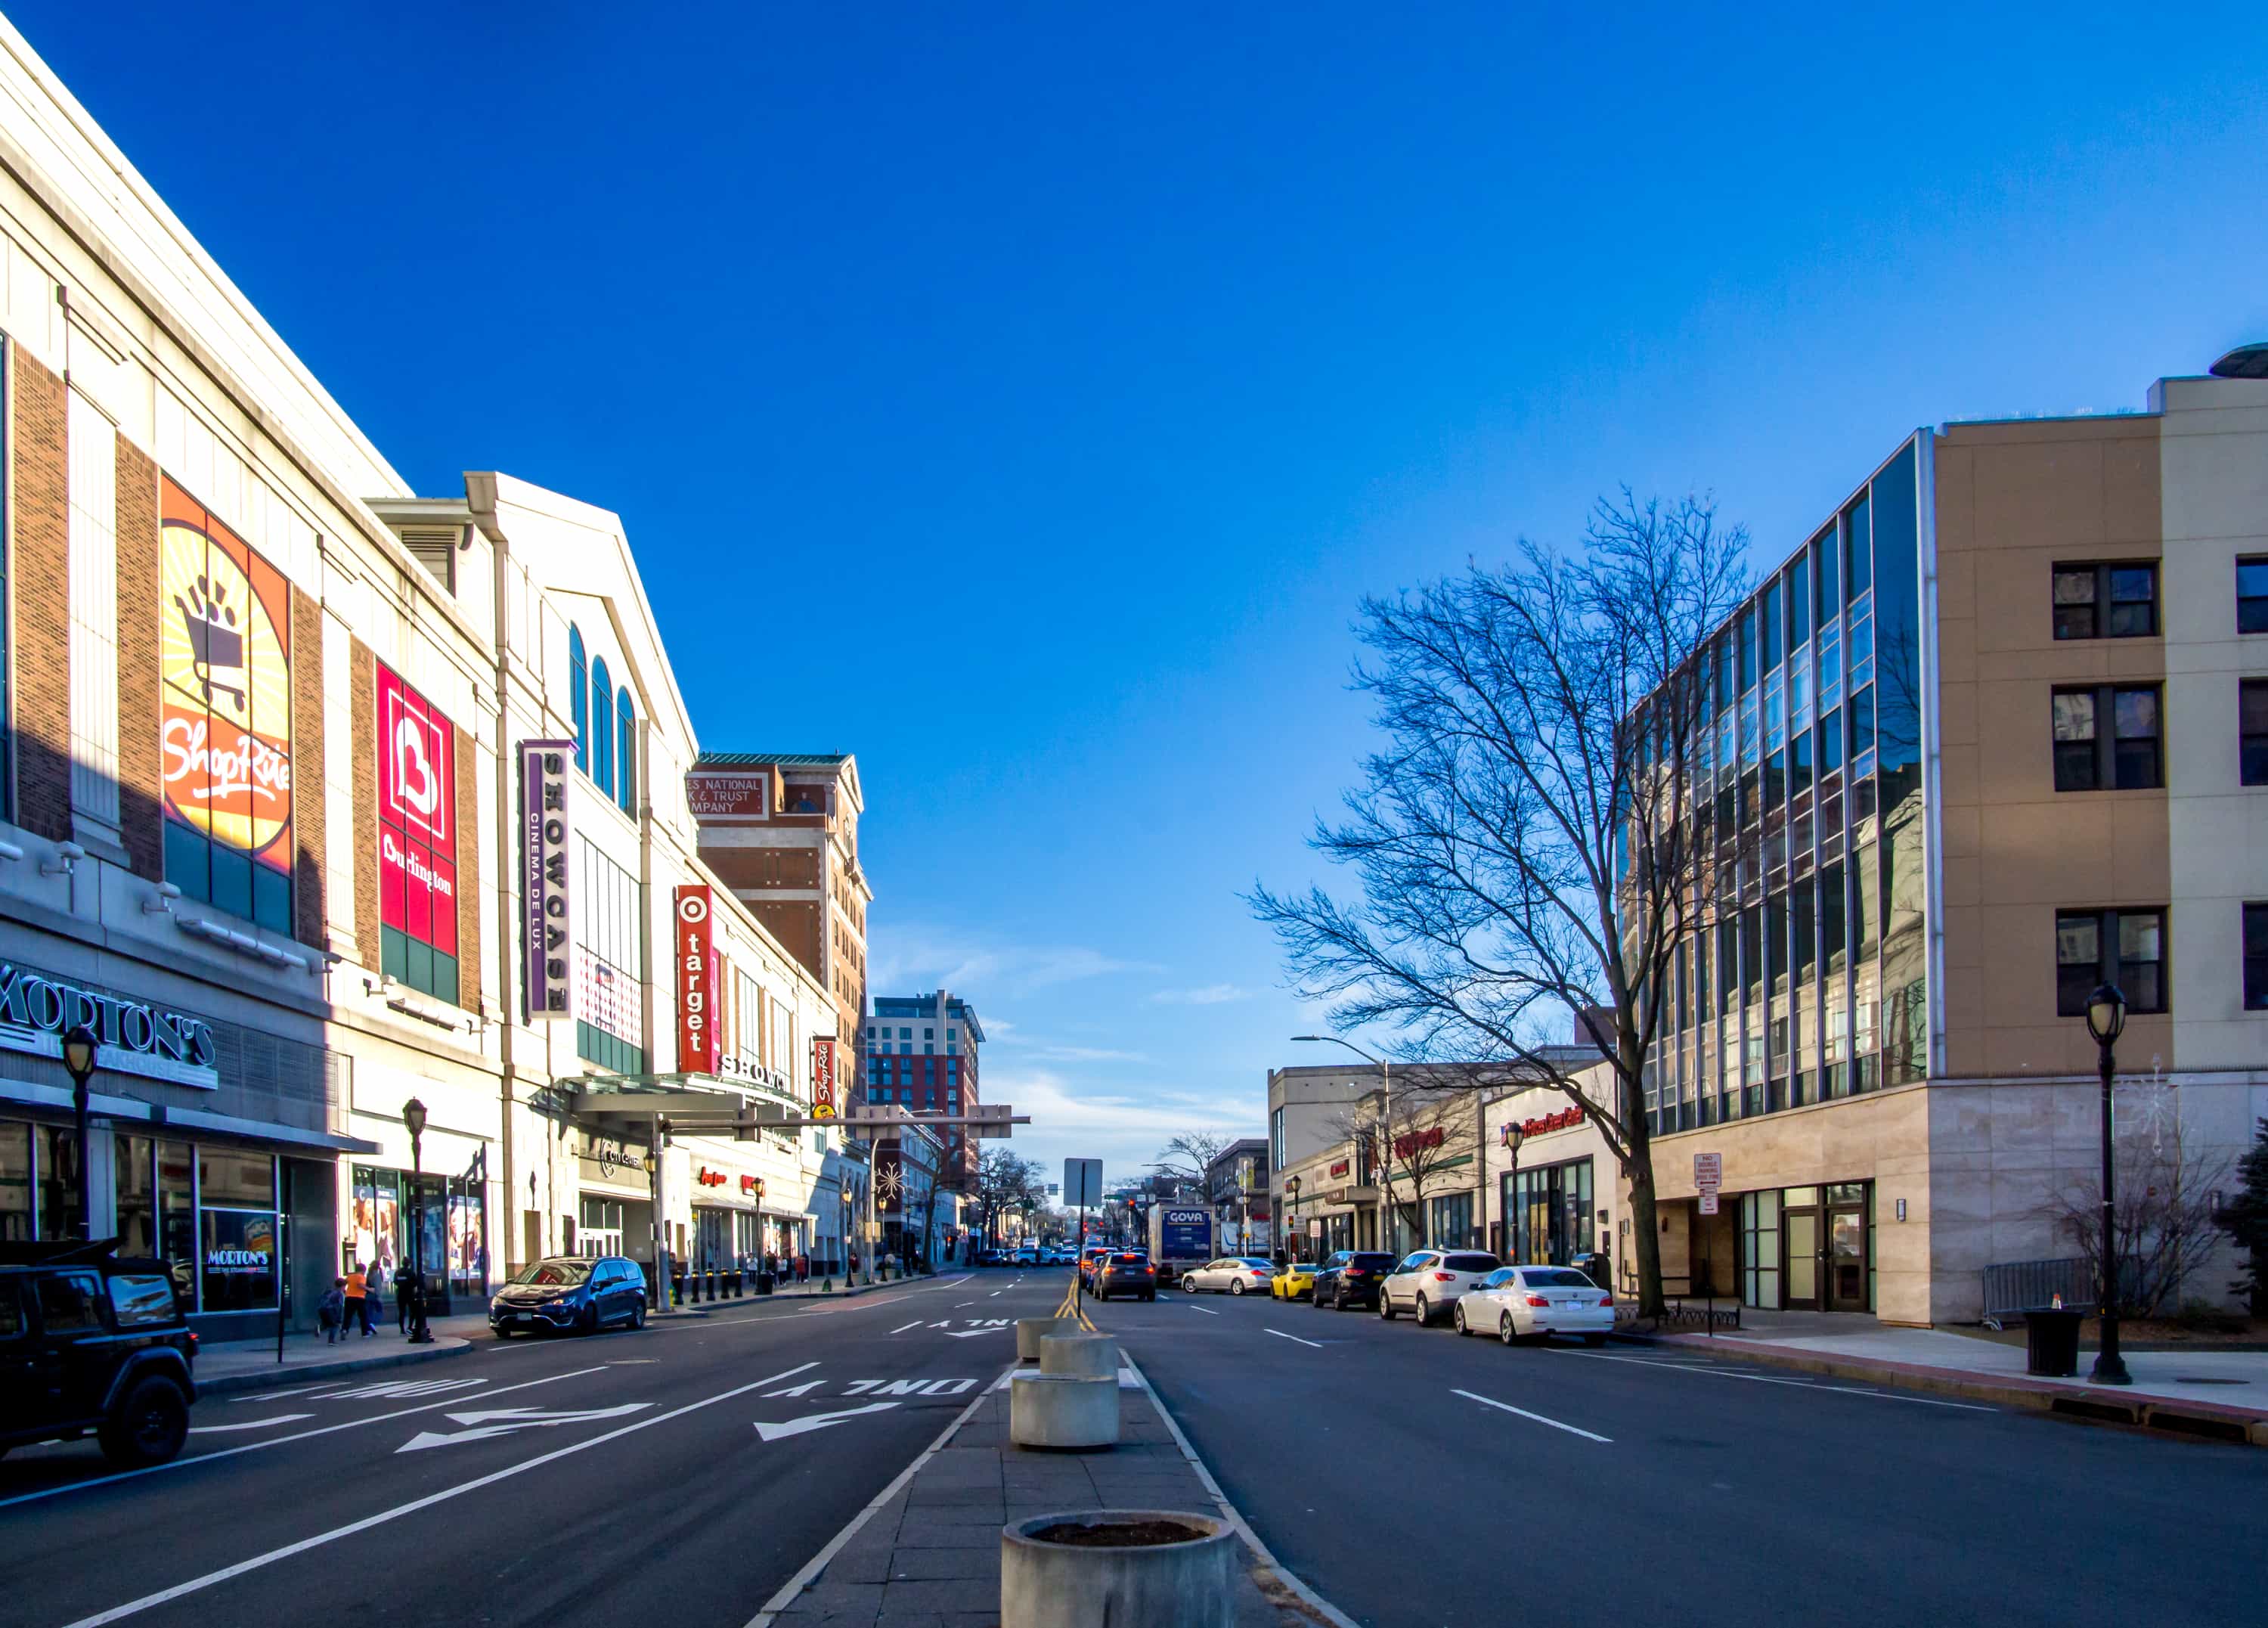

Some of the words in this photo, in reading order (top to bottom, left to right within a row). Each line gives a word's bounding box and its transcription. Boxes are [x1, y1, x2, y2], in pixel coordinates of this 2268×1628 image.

[163, 718, 290, 798] ShopRite
[706, 780, 760, 790] NATIONAL
[712, 791, 750, 802] TRUST
[692, 802, 735, 813] MPANY
[530, 813, 541, 881] CINEMA
[383, 833, 452, 896] Burlington
[544, 752, 567, 1012] SHOWCASE
[531, 889, 541, 910] DE
[531, 915, 541, 950] LUX
[686, 933, 703, 1052] target
[818, 1044, 832, 1102] ShopRite
[208, 1249, 268, 1264] MORTON'S
[926, 1319, 1018, 1328] NLY
[760, 1378, 979, 1397] ONLY
